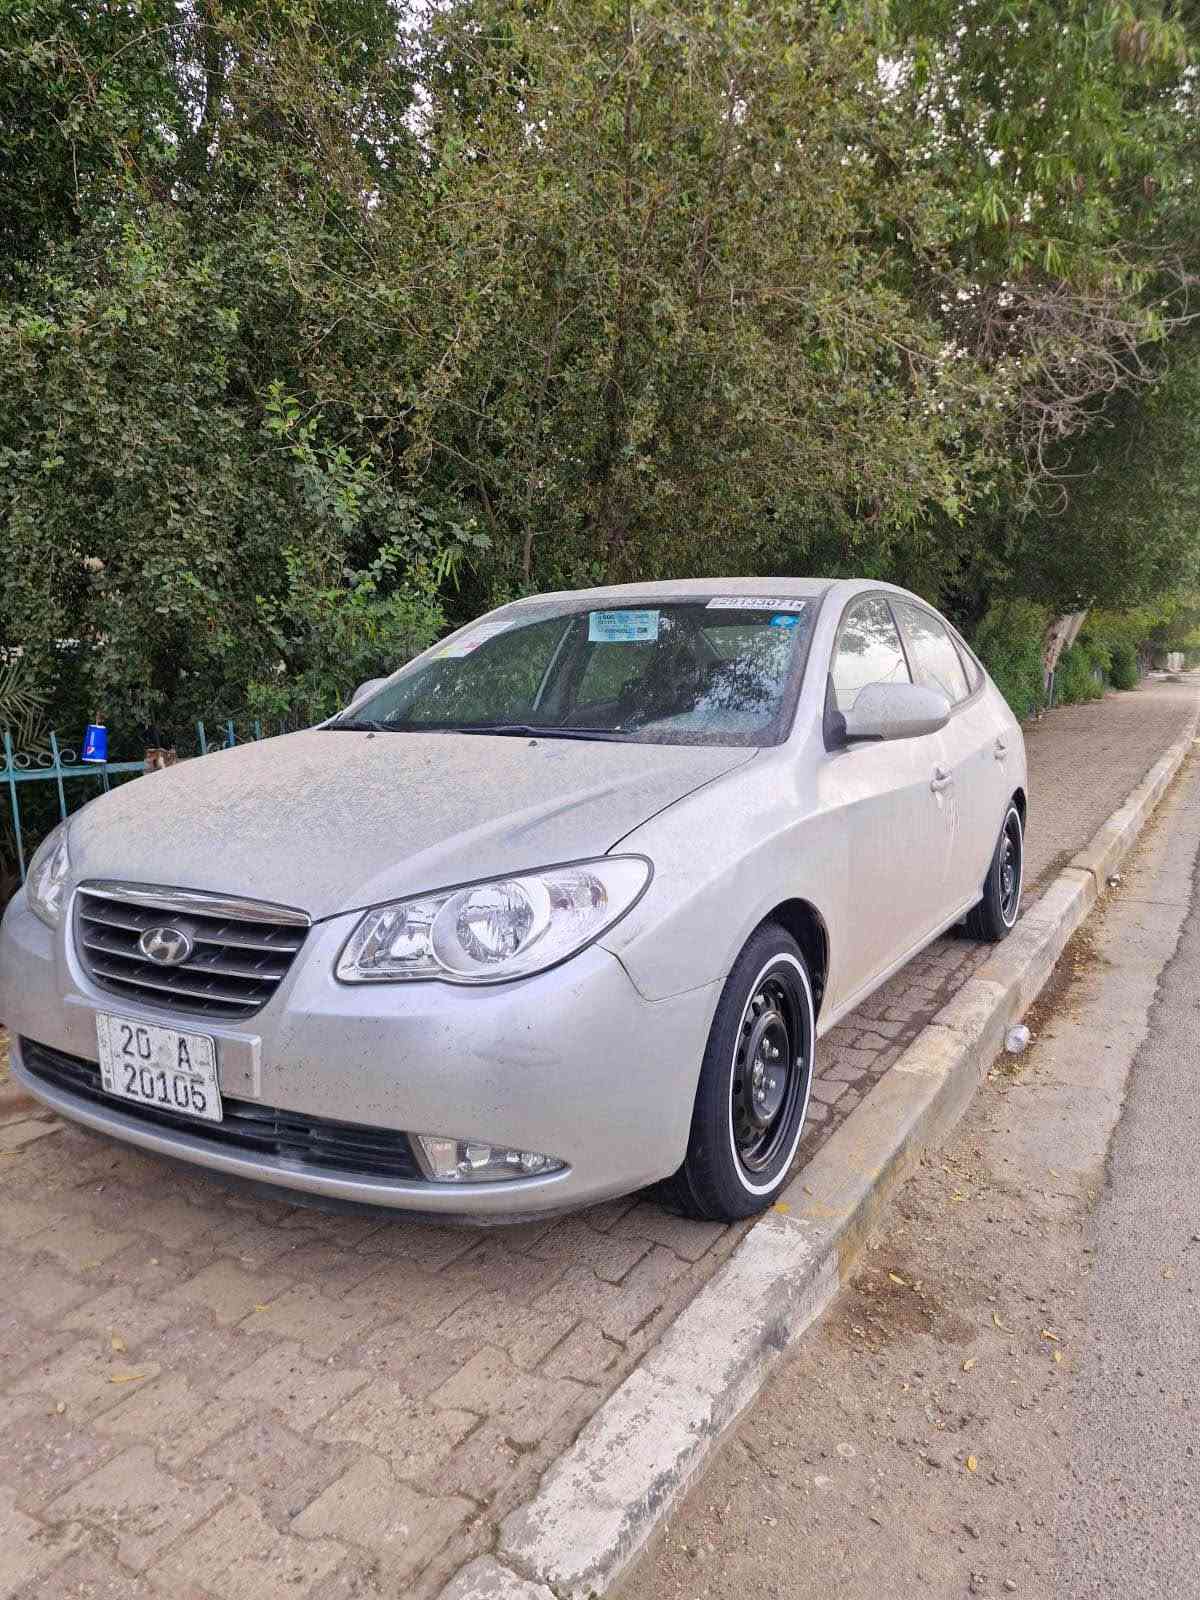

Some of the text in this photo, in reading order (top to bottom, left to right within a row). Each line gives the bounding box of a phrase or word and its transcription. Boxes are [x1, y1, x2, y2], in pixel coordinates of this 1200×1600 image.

[120, 1024, 151, 1059] 20
[178, 1037, 193, 1071] A
[123, 1063, 207, 1113] 20105
